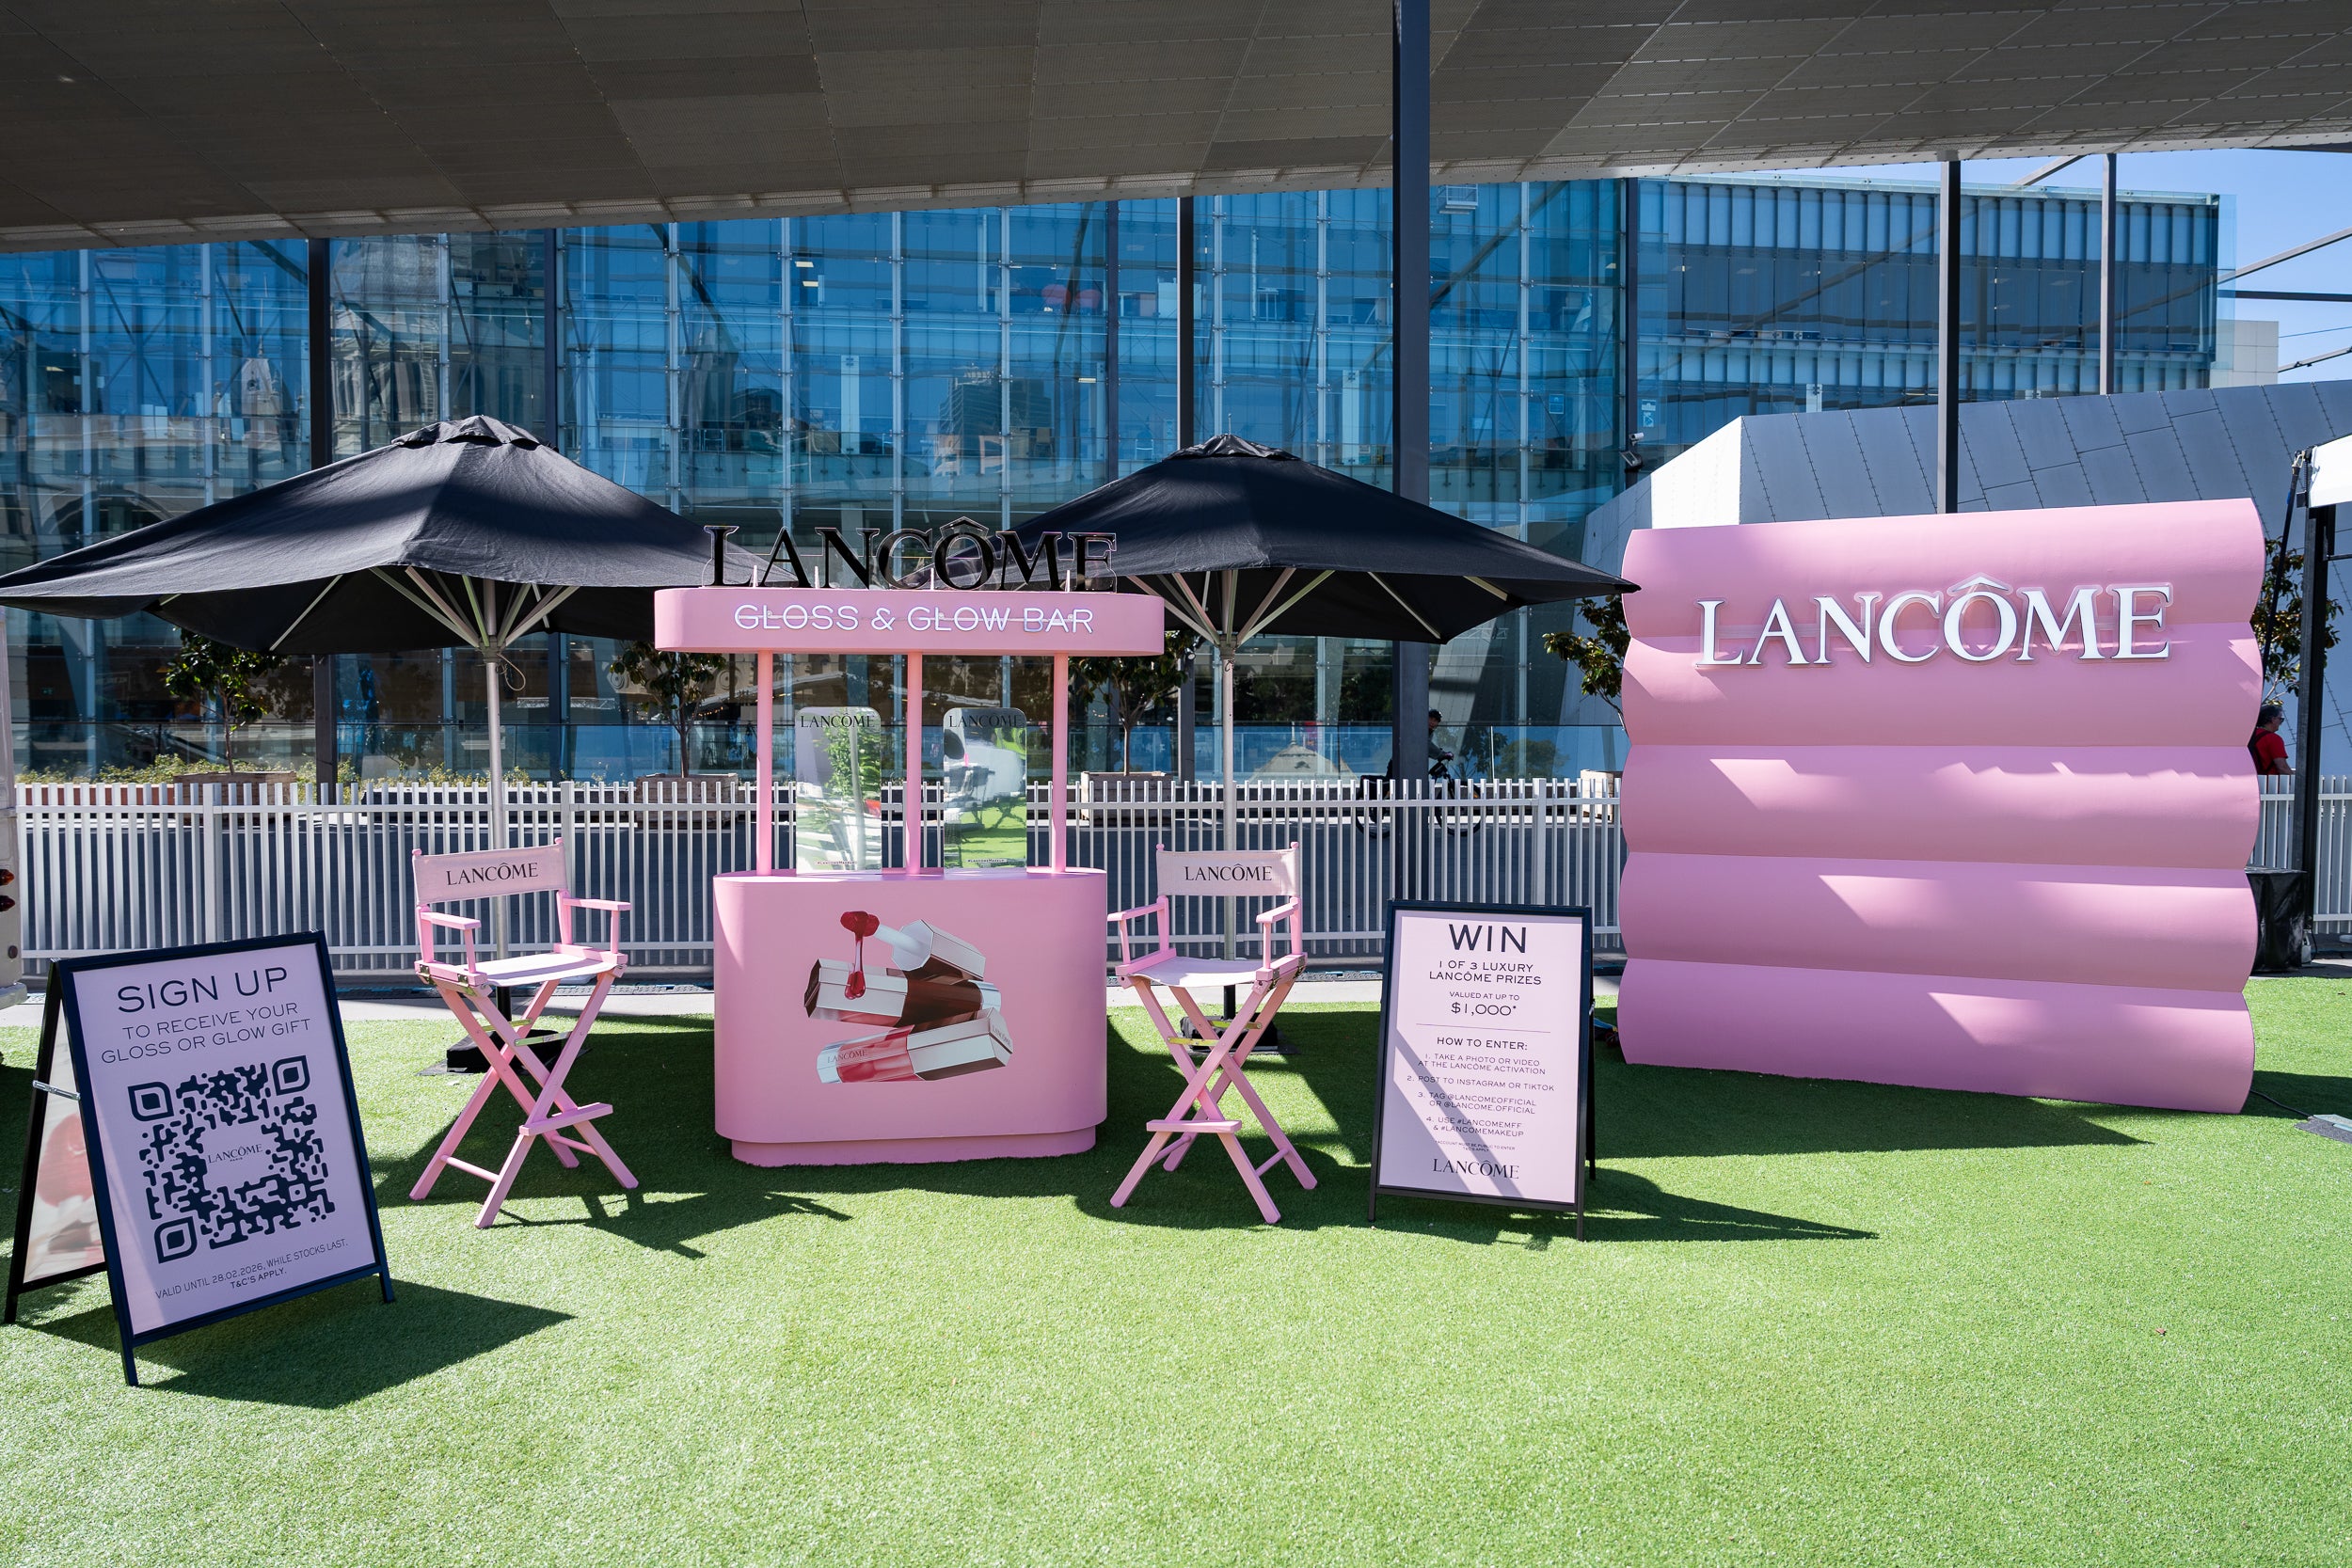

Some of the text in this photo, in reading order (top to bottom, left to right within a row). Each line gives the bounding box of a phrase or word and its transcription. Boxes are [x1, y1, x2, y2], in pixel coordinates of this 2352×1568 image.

[703, 517, 1117, 592] LANCÔME
[734, 604, 1093, 634] GLOSS & GLOW BAR
[1695, 575, 2171, 668] LANCÔME
[800, 712, 875, 728] LANCÔME
[446, 862, 539, 886] LANCÔME
[1184, 863, 1273, 881] LANCÔME
[1449, 923, 1527, 954] WIN
[1448, 959, 1465, 969] OF
[1483, 962, 1534, 973] LUXURY
[1429, 971, 1542, 985] LANCÔME PRIZES
[117, 966, 288, 1013] SIGN UP
[1449, 990, 1482, 999] VALUED
[122, 1002, 298, 1040] TO RECEIVE YOUR
[101, 1018, 310, 1064] GLOSS OR GLOW GIFT
[1437, 1037, 1528, 1051] HOW TO ENTER:
[1431, 1060, 1448, 1069] THE
[1451, 1062, 1492, 1071] LANCÔME
[1494, 1065, 1546, 1075] ACTIVATION
[1434, 1053, 1455, 1061] TAKE
[1466, 1054, 1496, 1064] PHOTO
[1513, 1058, 1540, 1067] VIDEO
[1418, 1075, 1439, 1084] POST
[1456, 1079, 1505, 1088] INSTAGRAM
[1523, 1083, 1555, 1091] TIKTOK
[1443, 1101, 1535, 1115] @LANCOME.OFFICIAL
[1447, 1093, 1536, 1106] @LANCOMEOFFICIAL
[1441, 1125, 1524, 1137] #LANCOMEMAKEUP
[1457, 1118, 1522, 1129] #LANCOMEMFF
[208, 1143, 263, 1164] LANCÔME
[1433, 1158, 1519, 1180] LANCÔME
[154, 1238, 349, 1300] VALID UNTIL 28.02.2026, WHILE STOCKS LAST.
[230, 1267, 287, 1290] T&C'S APPLY.
